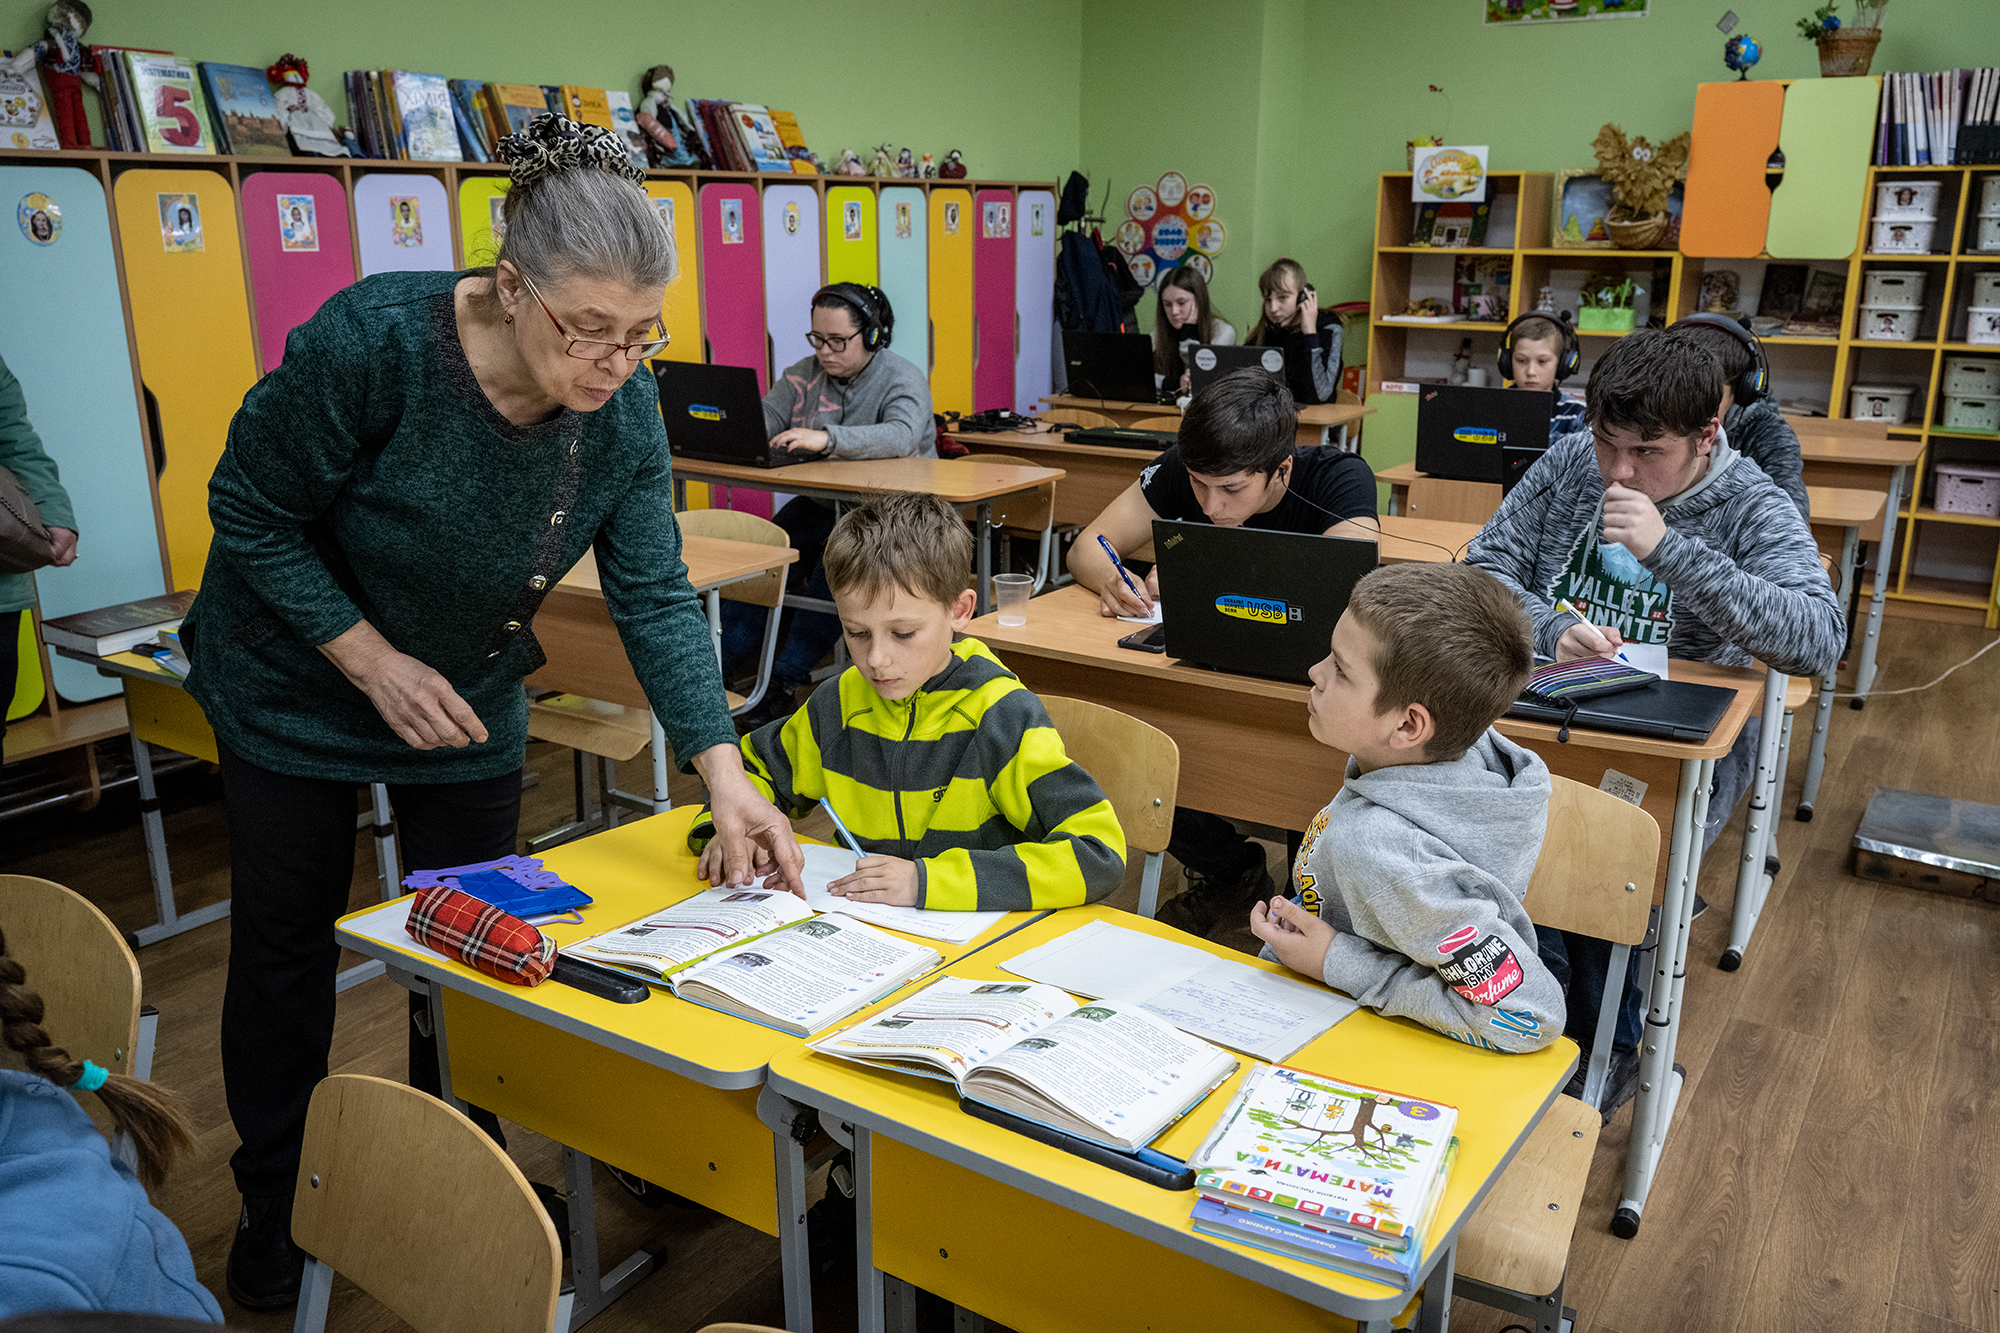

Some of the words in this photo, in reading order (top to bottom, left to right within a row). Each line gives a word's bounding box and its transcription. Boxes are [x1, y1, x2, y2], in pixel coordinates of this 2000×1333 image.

[402, 90, 448, 108] ХІМІЯ
[155, 85, 201, 147] 5
[1247, 601, 1283, 619] USB
[1568, 572, 1661, 618] VALLEY
[1585, 603, 1672, 644] INVITE
[1440, 937, 1507, 983] CHLORINE
[1464, 973, 1480, 989] IS
[1476, 963, 1497, 983] MY
[1408, 1105, 1428, 1117] 3
[1236, 1152, 1393, 1198] МАТЕМАТИКА
[1238, 1217, 1282, 1235] САВЧЕНКО
